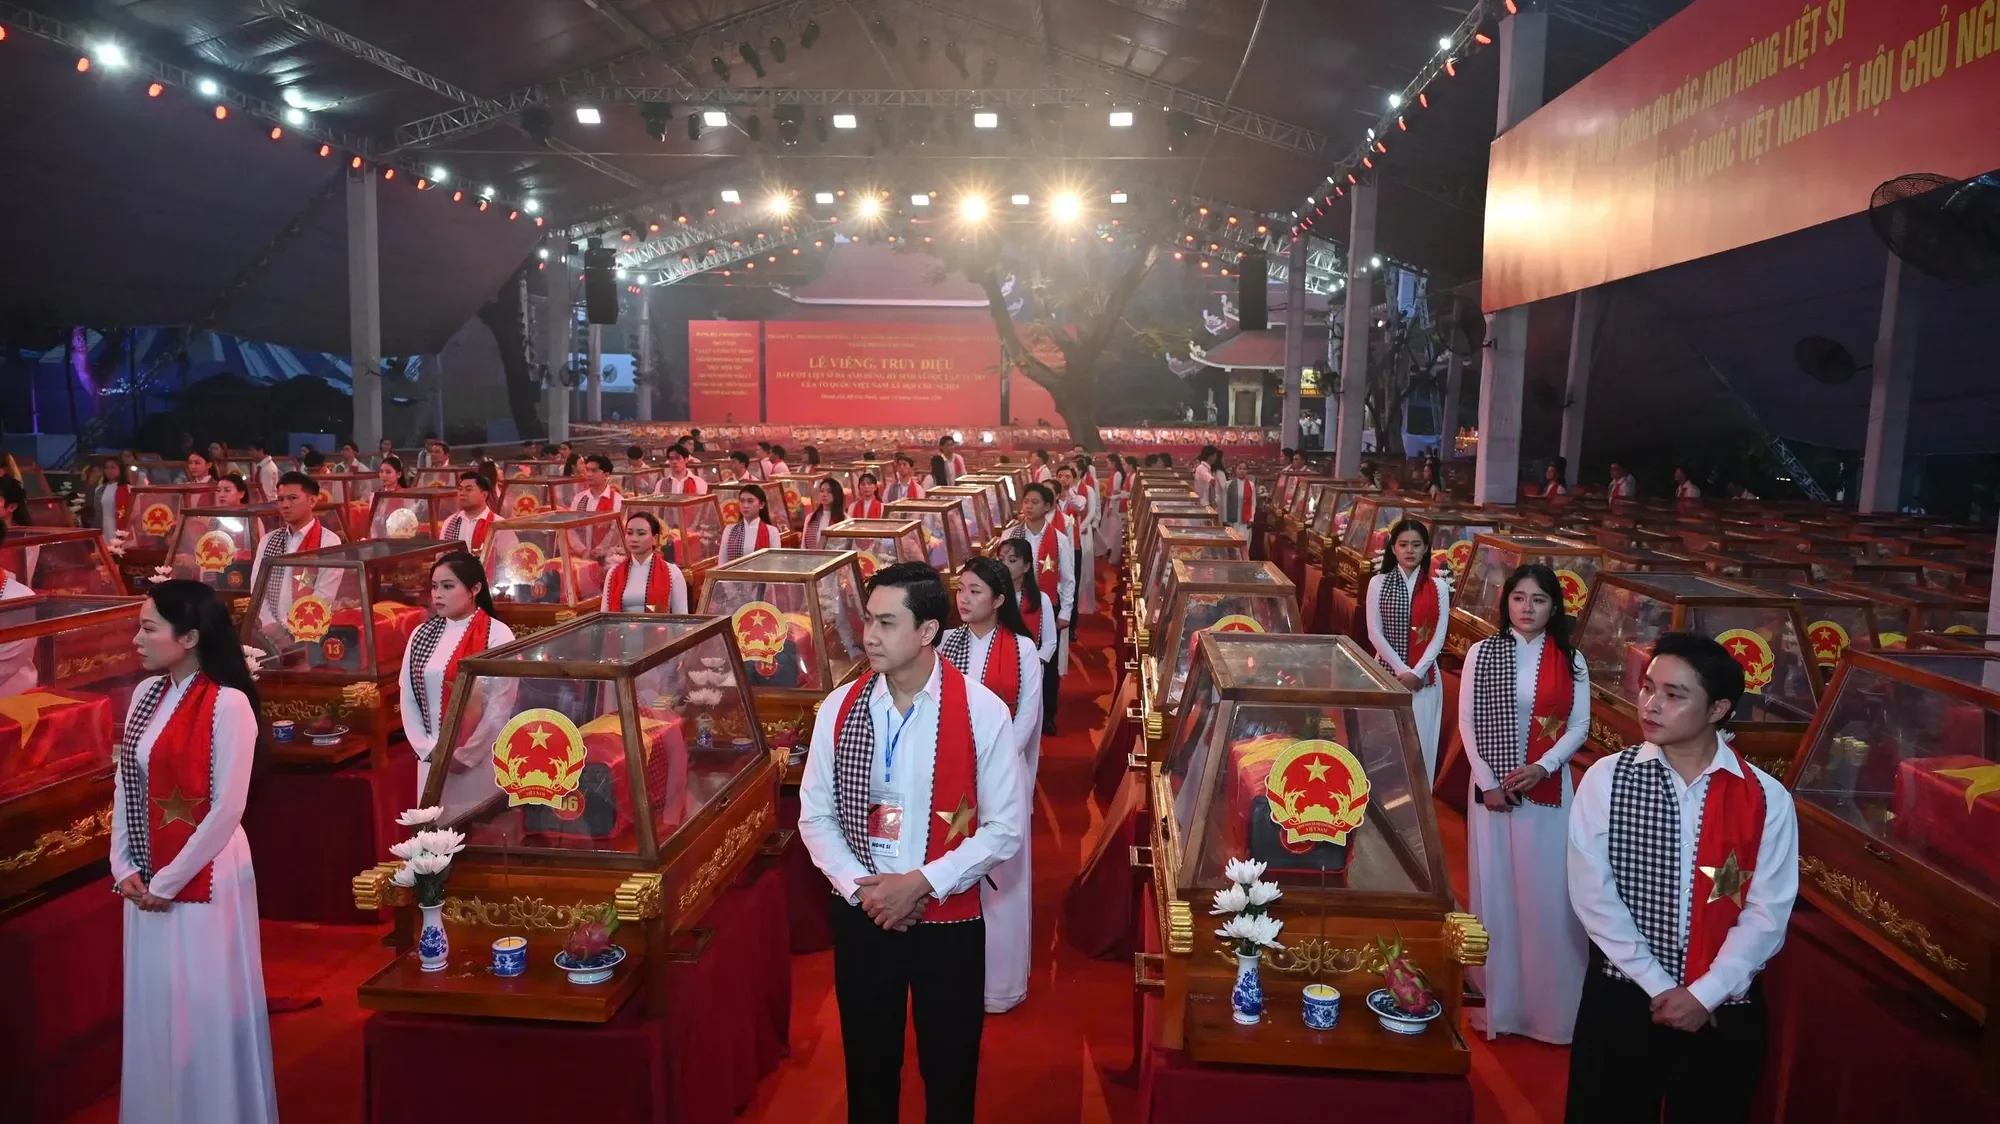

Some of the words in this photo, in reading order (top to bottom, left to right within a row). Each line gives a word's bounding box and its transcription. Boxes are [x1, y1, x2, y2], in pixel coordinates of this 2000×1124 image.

[1673, 73, 1699, 125] CÁC
[1701, 58, 1732, 111] ANH
[1735, 31, 1780, 94] HÙNG
[1784, 4, 1822, 70] LIỆT
[1699, 115, 1736, 180] QUỐC
[1741, 104, 1774, 165] VIỆT
[1778, 85, 1820, 147] NAM
[1824, 60, 1852, 127] XÃ
[1857, 44, 1894, 117] HỘI
[1900, 3, 1950, 93] CHỦ
[881, 357, 915, 370] TRUY
[327, 643, 341, 655] 13
